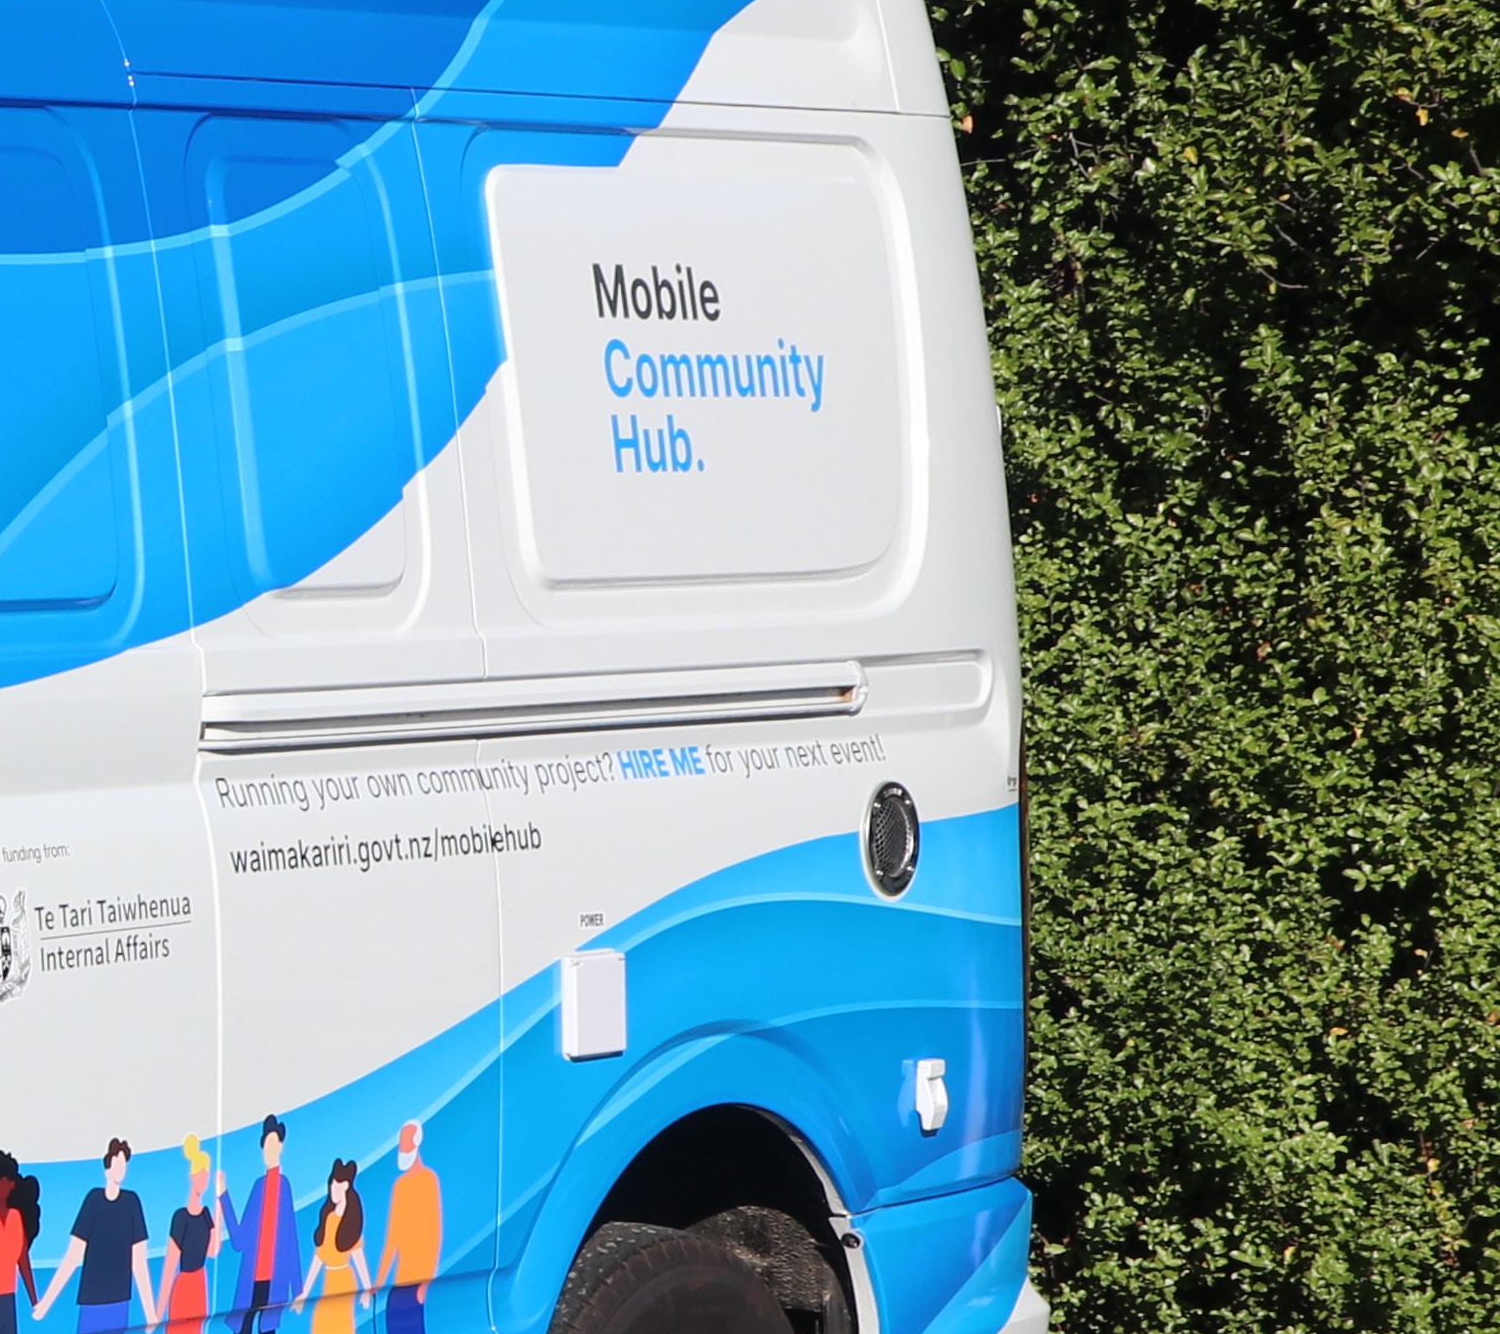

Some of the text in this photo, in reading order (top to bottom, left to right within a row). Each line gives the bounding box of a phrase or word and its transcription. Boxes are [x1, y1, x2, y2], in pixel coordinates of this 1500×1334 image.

[591, 263, 721, 322] Mobile
[603, 337, 825, 413] Community
[610, 414, 705, 473] Hub.
[216, 733, 887, 813] Running your own community project? HIRE ME for your next event!
[2, 845, 42, 863] funding
[43, 844, 71, 858] from:
[229, 820, 543, 875] waimakariri.govt.nz/mobilehub
[33, 893, 192, 933] Te Tari Taiwhenua
[580, 913, 604, 928] POWER
[38, 935, 171, 973] Internal Affairs
